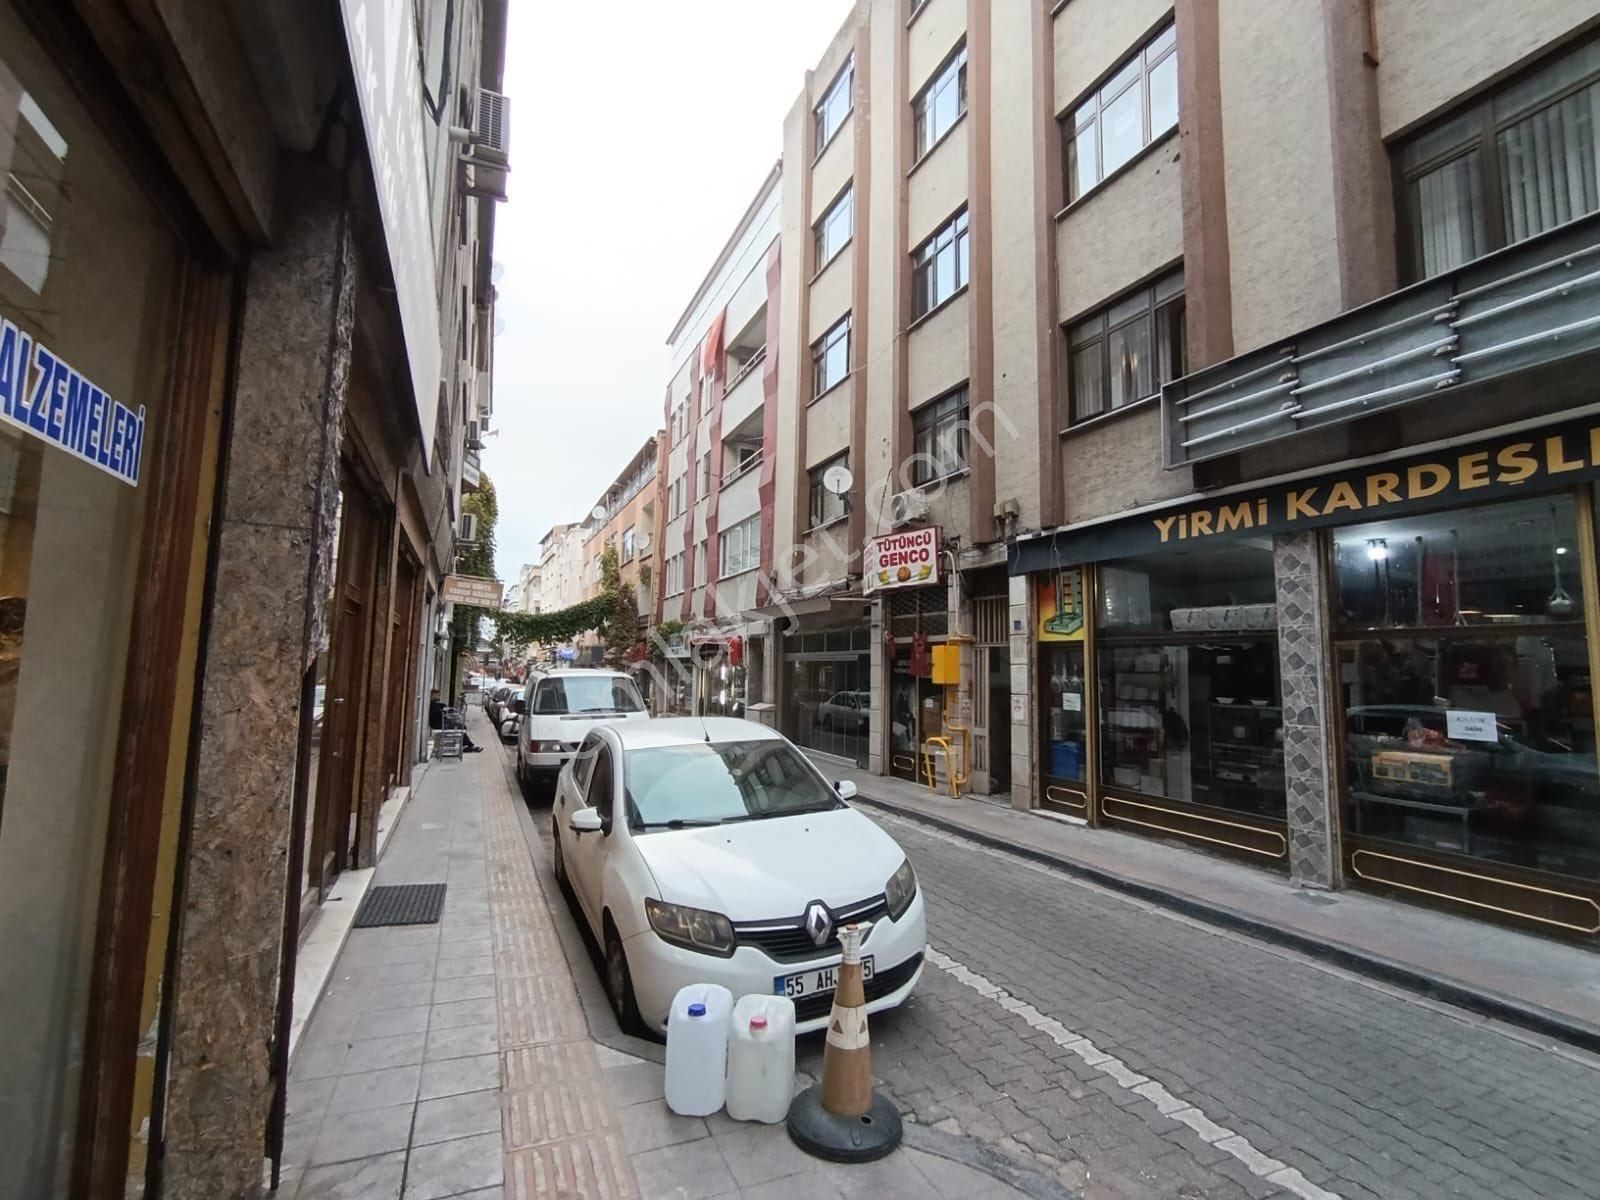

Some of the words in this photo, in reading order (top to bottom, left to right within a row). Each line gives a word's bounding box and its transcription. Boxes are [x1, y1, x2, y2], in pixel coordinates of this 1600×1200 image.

[879, 548, 930, 568] GENCO
[786, 975, 804, 996] 55
[816, 969, 838, 991] AH
